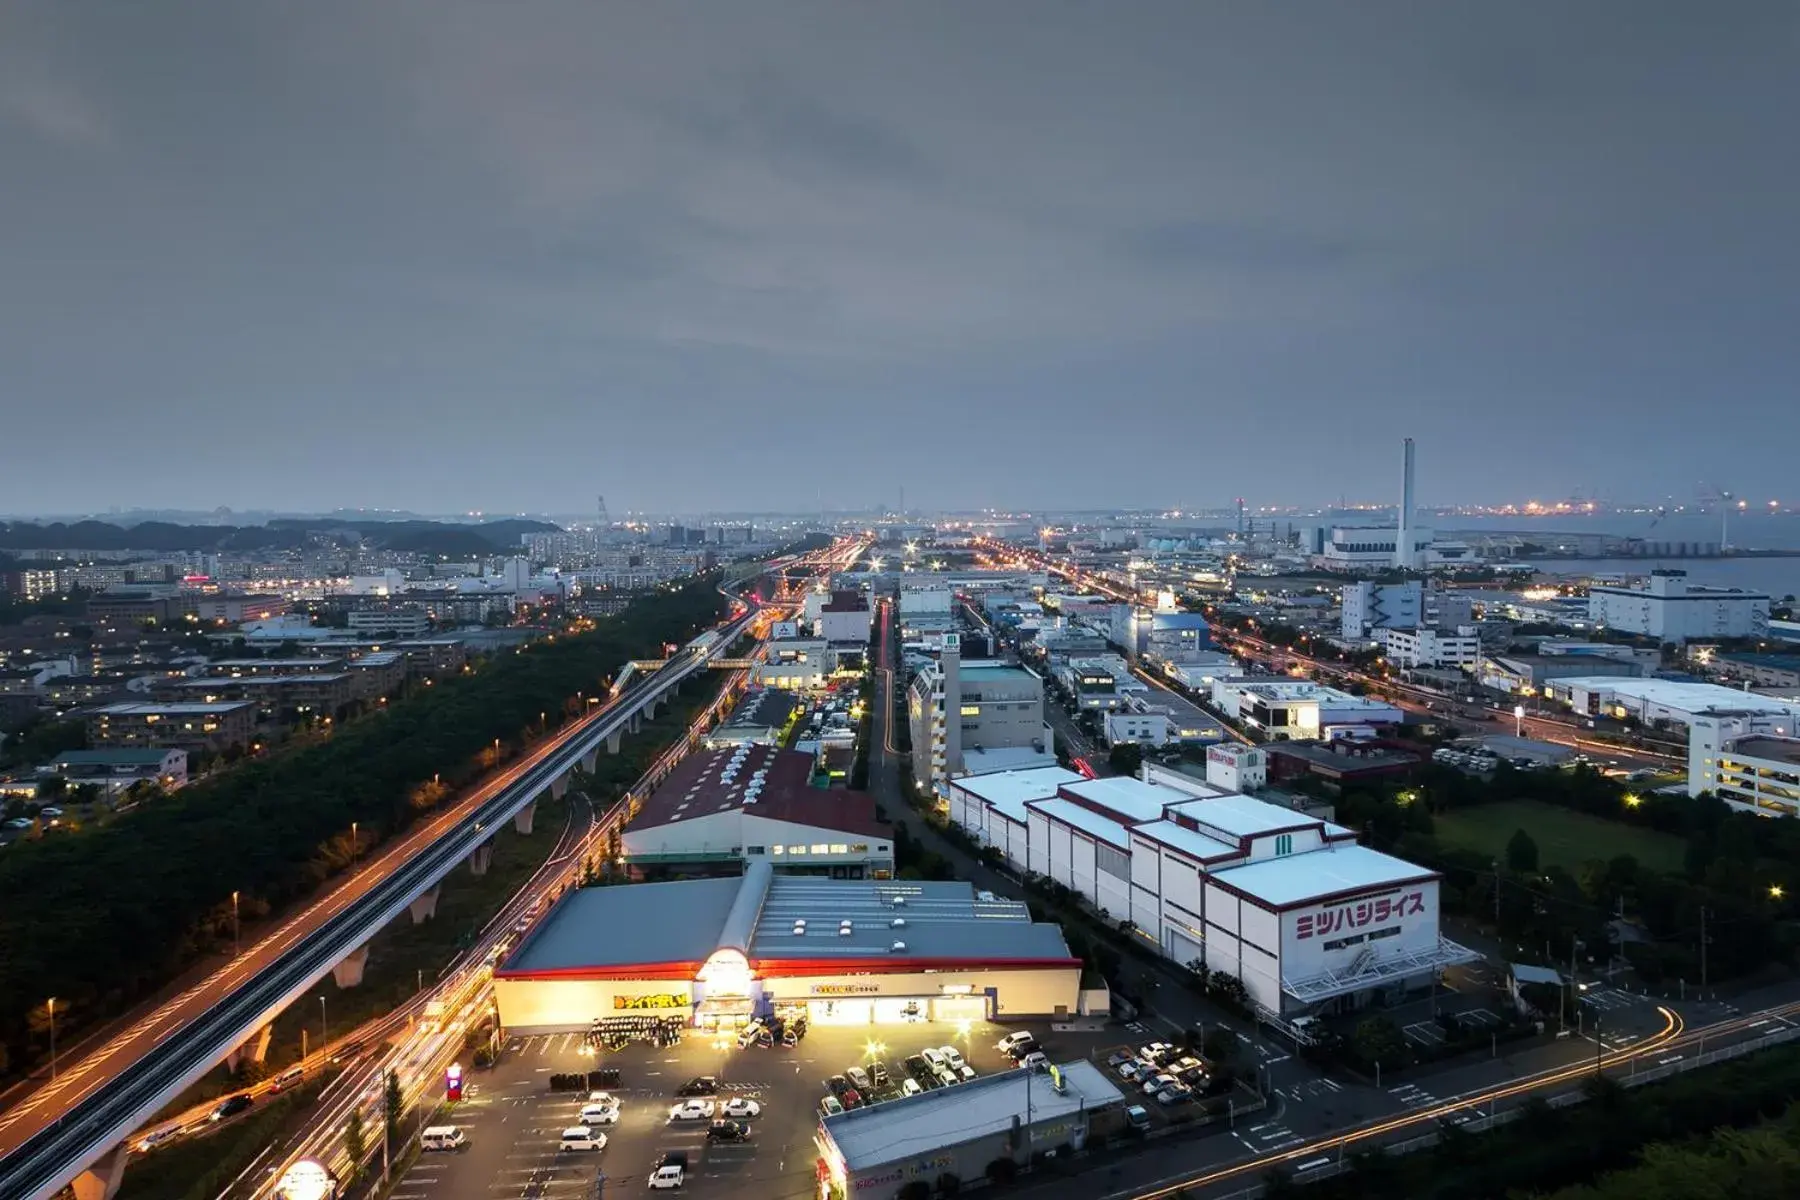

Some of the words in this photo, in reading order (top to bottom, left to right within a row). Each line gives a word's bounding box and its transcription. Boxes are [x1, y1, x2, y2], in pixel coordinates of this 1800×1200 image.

[1297, 892, 1425, 940] ミツハシライス
